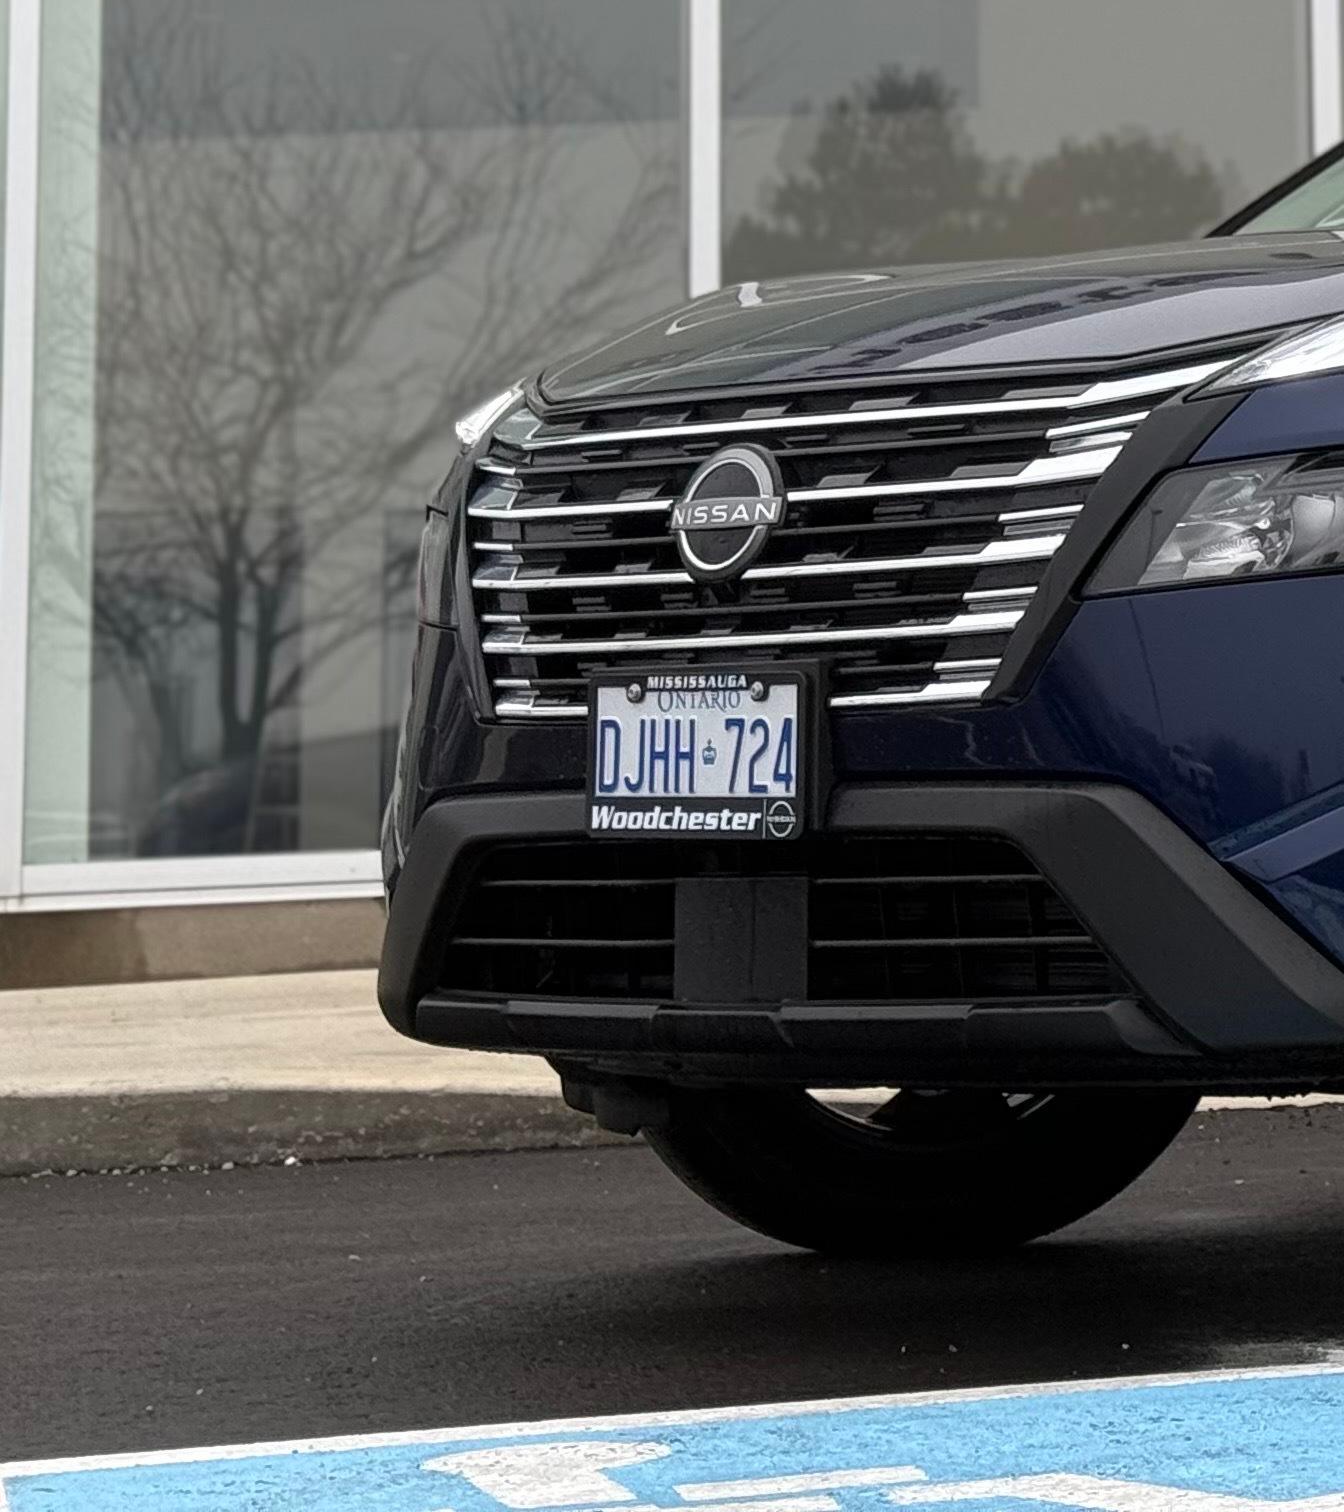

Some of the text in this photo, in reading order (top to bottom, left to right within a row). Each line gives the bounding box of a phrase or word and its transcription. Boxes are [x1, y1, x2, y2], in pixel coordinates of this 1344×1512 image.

[671, 502, 777, 526] NISSAN
[646, 674, 748, 689] MISSISSAUGA
[657, 690, 741, 713] ONTARIO
[599, 717, 793, 794] DJHH 724
[591, 805, 762, 831] Woodchester
